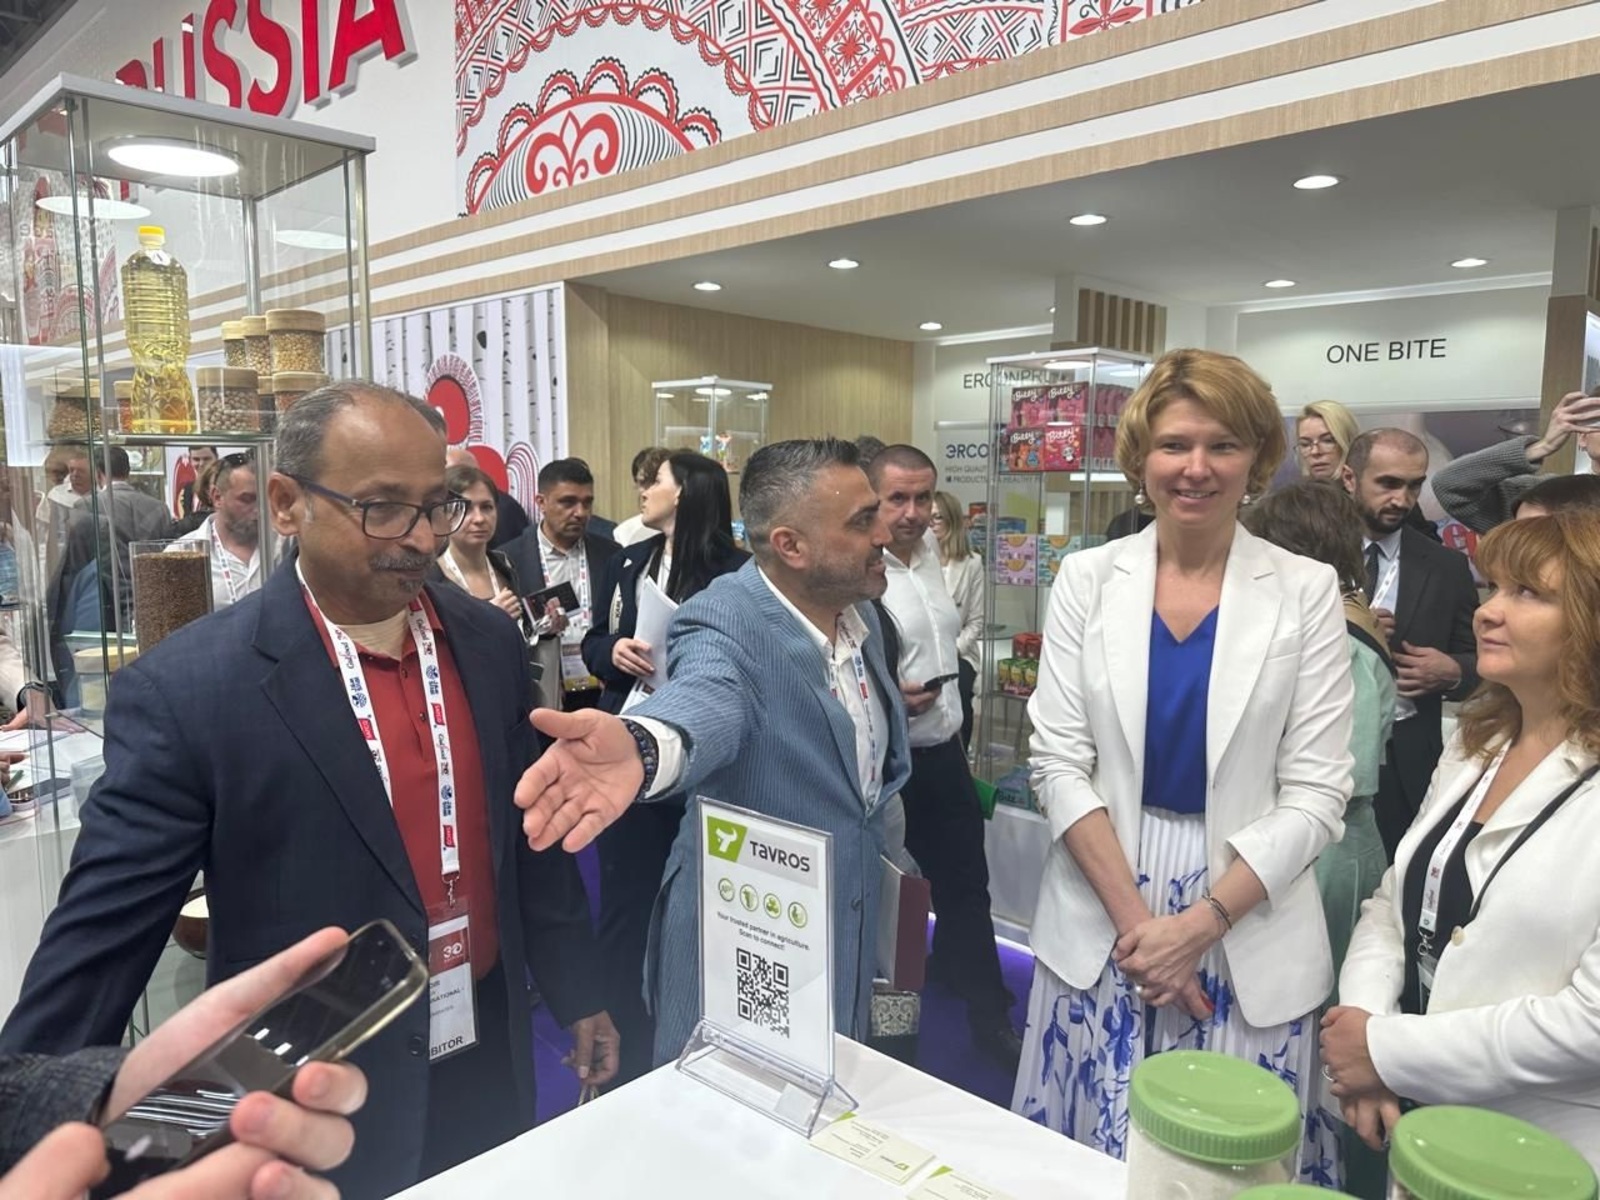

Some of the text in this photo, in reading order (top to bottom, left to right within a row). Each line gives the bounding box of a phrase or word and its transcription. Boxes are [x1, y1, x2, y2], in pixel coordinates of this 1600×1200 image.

[1326, 338, 1447, 364] ONE BITE
[964, 464, 988, 473] QUALIT
[717, 911, 729, 920] Your
[730, 916, 749, 928] trusted
[749, 924, 769, 936] partner
[770, 930, 776, 938] in
[739, 928, 752, 939] Scan
[753, 933, 760, 942] to
